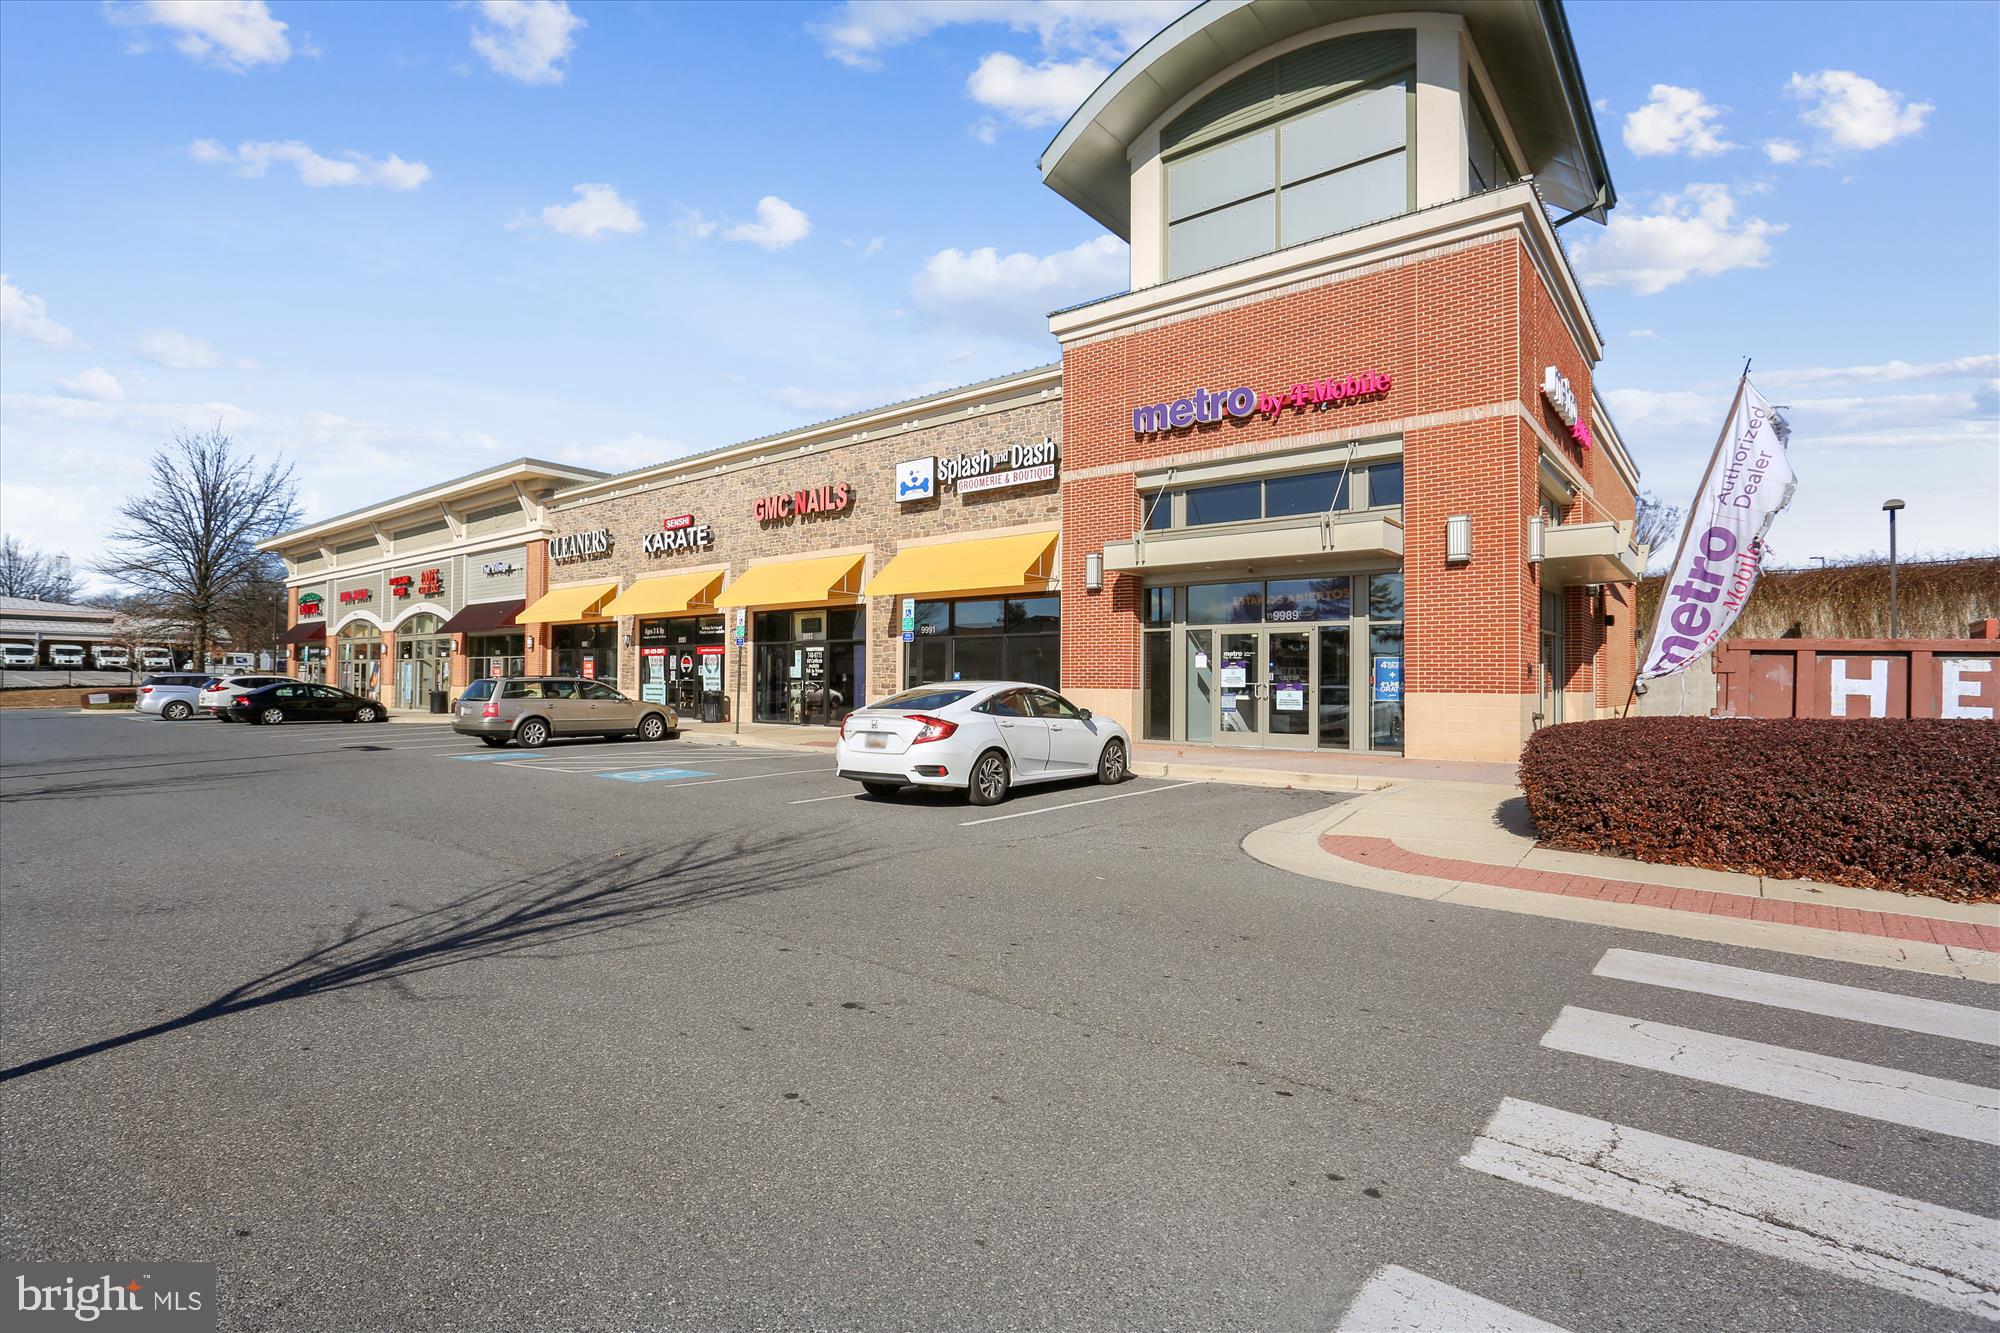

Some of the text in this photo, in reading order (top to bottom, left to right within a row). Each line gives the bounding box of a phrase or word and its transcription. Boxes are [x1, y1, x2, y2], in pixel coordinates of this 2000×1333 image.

[1133, 386, 1256, 433] metro
[1259, 390, 1287, 417] by
[937, 436, 1055, 485] Splash and Dash
[1716, 406, 1766, 506] Authorized
[958, 474, 1003, 491] GROOMERIE
[1013, 464, 1053, 482] BOUTIQUE
[1733, 450, 1772, 510] Dealer
[754, 482, 848, 521] GMC NAILS
[666, 517, 689, 528] SENSHI
[548, 528, 608, 560] CLEANERS
[642, 525, 708, 553] KARATE
[1287, 587, 1350, 602] ABIERTOS
[1651, 526, 1737, 673] metro
[920, 625, 936, 634] 9991
[1272, 610, 1299, 621] 9989
